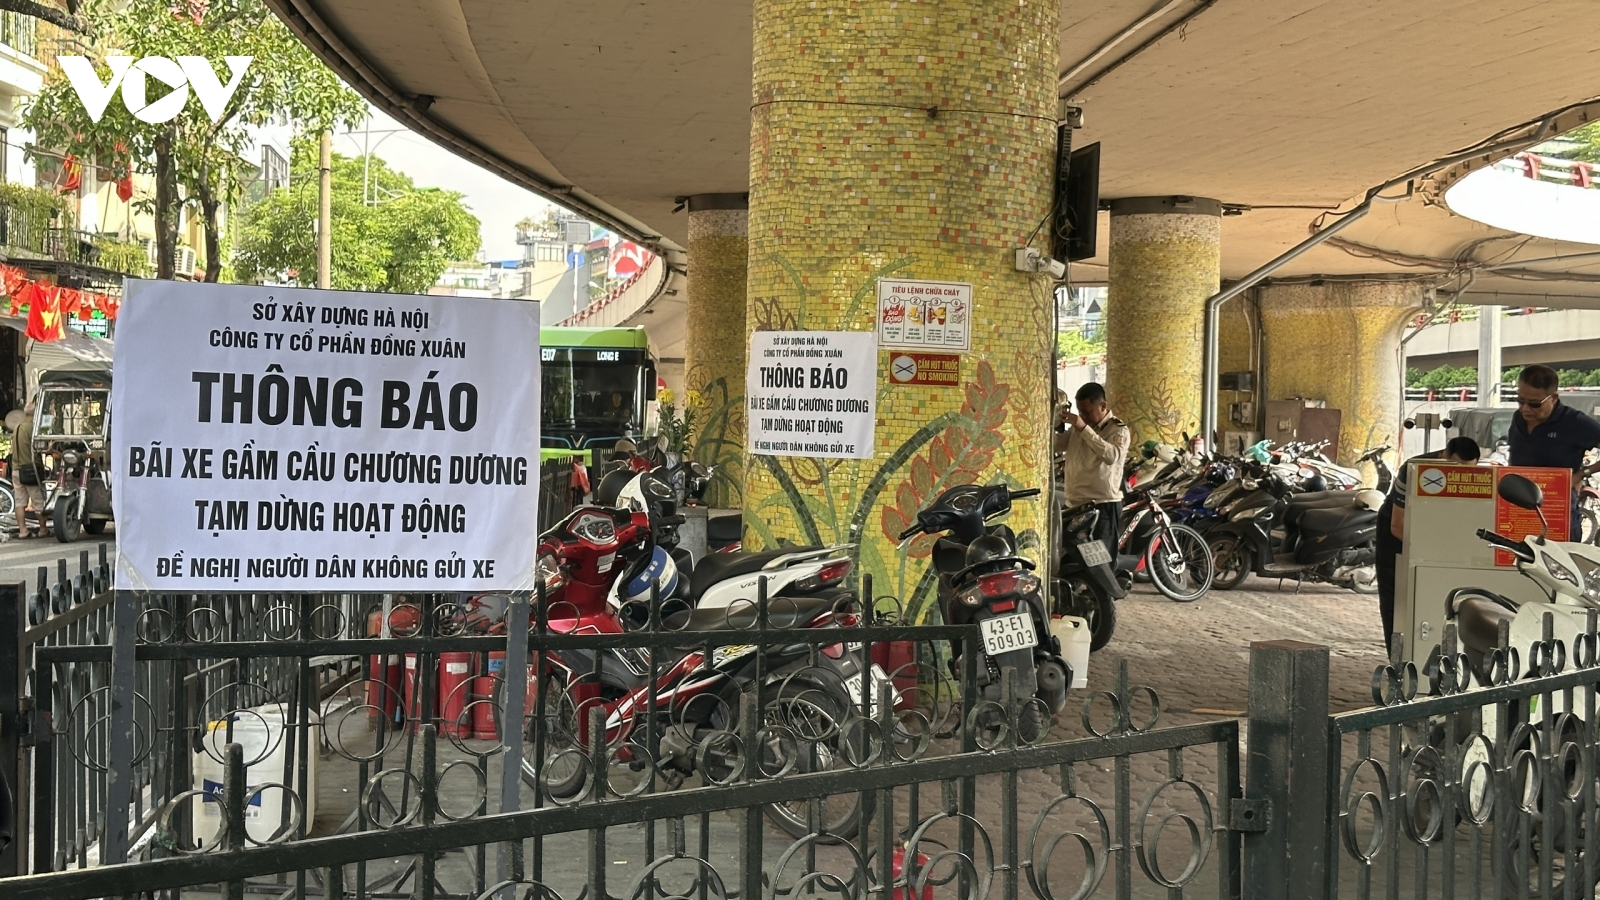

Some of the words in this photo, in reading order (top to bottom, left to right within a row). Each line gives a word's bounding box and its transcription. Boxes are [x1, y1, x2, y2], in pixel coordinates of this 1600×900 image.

[944, 288, 960, 296] CHÁY
[252, 296, 277, 321] SỞ
[281, 305, 316, 324] XÂY
[321, 306, 369, 329] DỰNG
[373, 307, 396, 328] HÀ
[400, 310, 430, 332] NỘI
[209, 327, 258, 349] CÔNG
[264, 332, 283, 350] TY
[289, 328, 314, 352] CỔ
[318, 330, 364, 355] PHẦN
[369, 333, 415, 357] ĐỒNG
[420, 338, 466, 359] XUÂN
[816, 337, 828, 347] NỘI
[541, 349, 556, 361] E07
[615, 352, 619, 361] E
[824, 348, 842, 358] XUÂN
[918, 359, 929, 368] CẤM
[931, 359, 941, 369] HÚT
[942, 358, 958, 370] THUỐC
[760, 362, 804, 388] THÔNG
[810, 363, 848, 389] BÁO
[918, 371, 927, 380] NO
[928, 372, 958, 381] SMOKING
[192, 363, 363, 428] THÔNG
[380, 370, 479, 432] BÁO
[782, 394, 796, 411] CẦU
[798, 398, 833, 412] CHƯƠNG
[836, 398, 869, 413] DƯƠNG
[761, 418, 773, 433] TẠM
[774, 416, 792, 432] DỪNG
[795, 420, 815, 435] HOẠT
[818, 418, 843, 436] ĐỘNG
[790, 441, 802, 452] DÂN
[804, 442, 828, 452] KHÔNG
[830, 440, 843, 453] GỬI
[845, 445, 854, 453] XE
[129, 440, 172, 478] BÃI
[180, 448, 213, 479] XE
[222, 439, 278, 481] GẦM
[287, 440, 335, 482] CẦU
[344, 453, 441, 484] CHƯƠNG
[449, 454, 528, 486] DƯƠNG
[1447, 471, 1460, 481] CẤM
[1461, 471, 1472, 482] HÚT
[1473, 471, 1492, 483] THUỐC
[1447, 485, 1457, 493] NO
[1459, 486, 1491, 494] SMOKING
[195, 500, 249, 537] TẠM
[257, 493, 324, 532] DỪNG
[333, 503, 395, 539] HOẠT
[401, 498, 466, 539] ĐỘNG
[156, 550, 185, 578] ĐỀ
[190, 557, 239, 582] NGHỊ
[247, 556, 309, 579] NGƯỜI
[316, 554, 357, 579] DÂN
[362, 555, 428, 580] KHÔNG
[434, 550, 466, 579] GỬI
[472, 559, 495, 579] XE
[990, 616, 1024, 635] 43-E1
[988, 630, 1034, 651] 509.03
